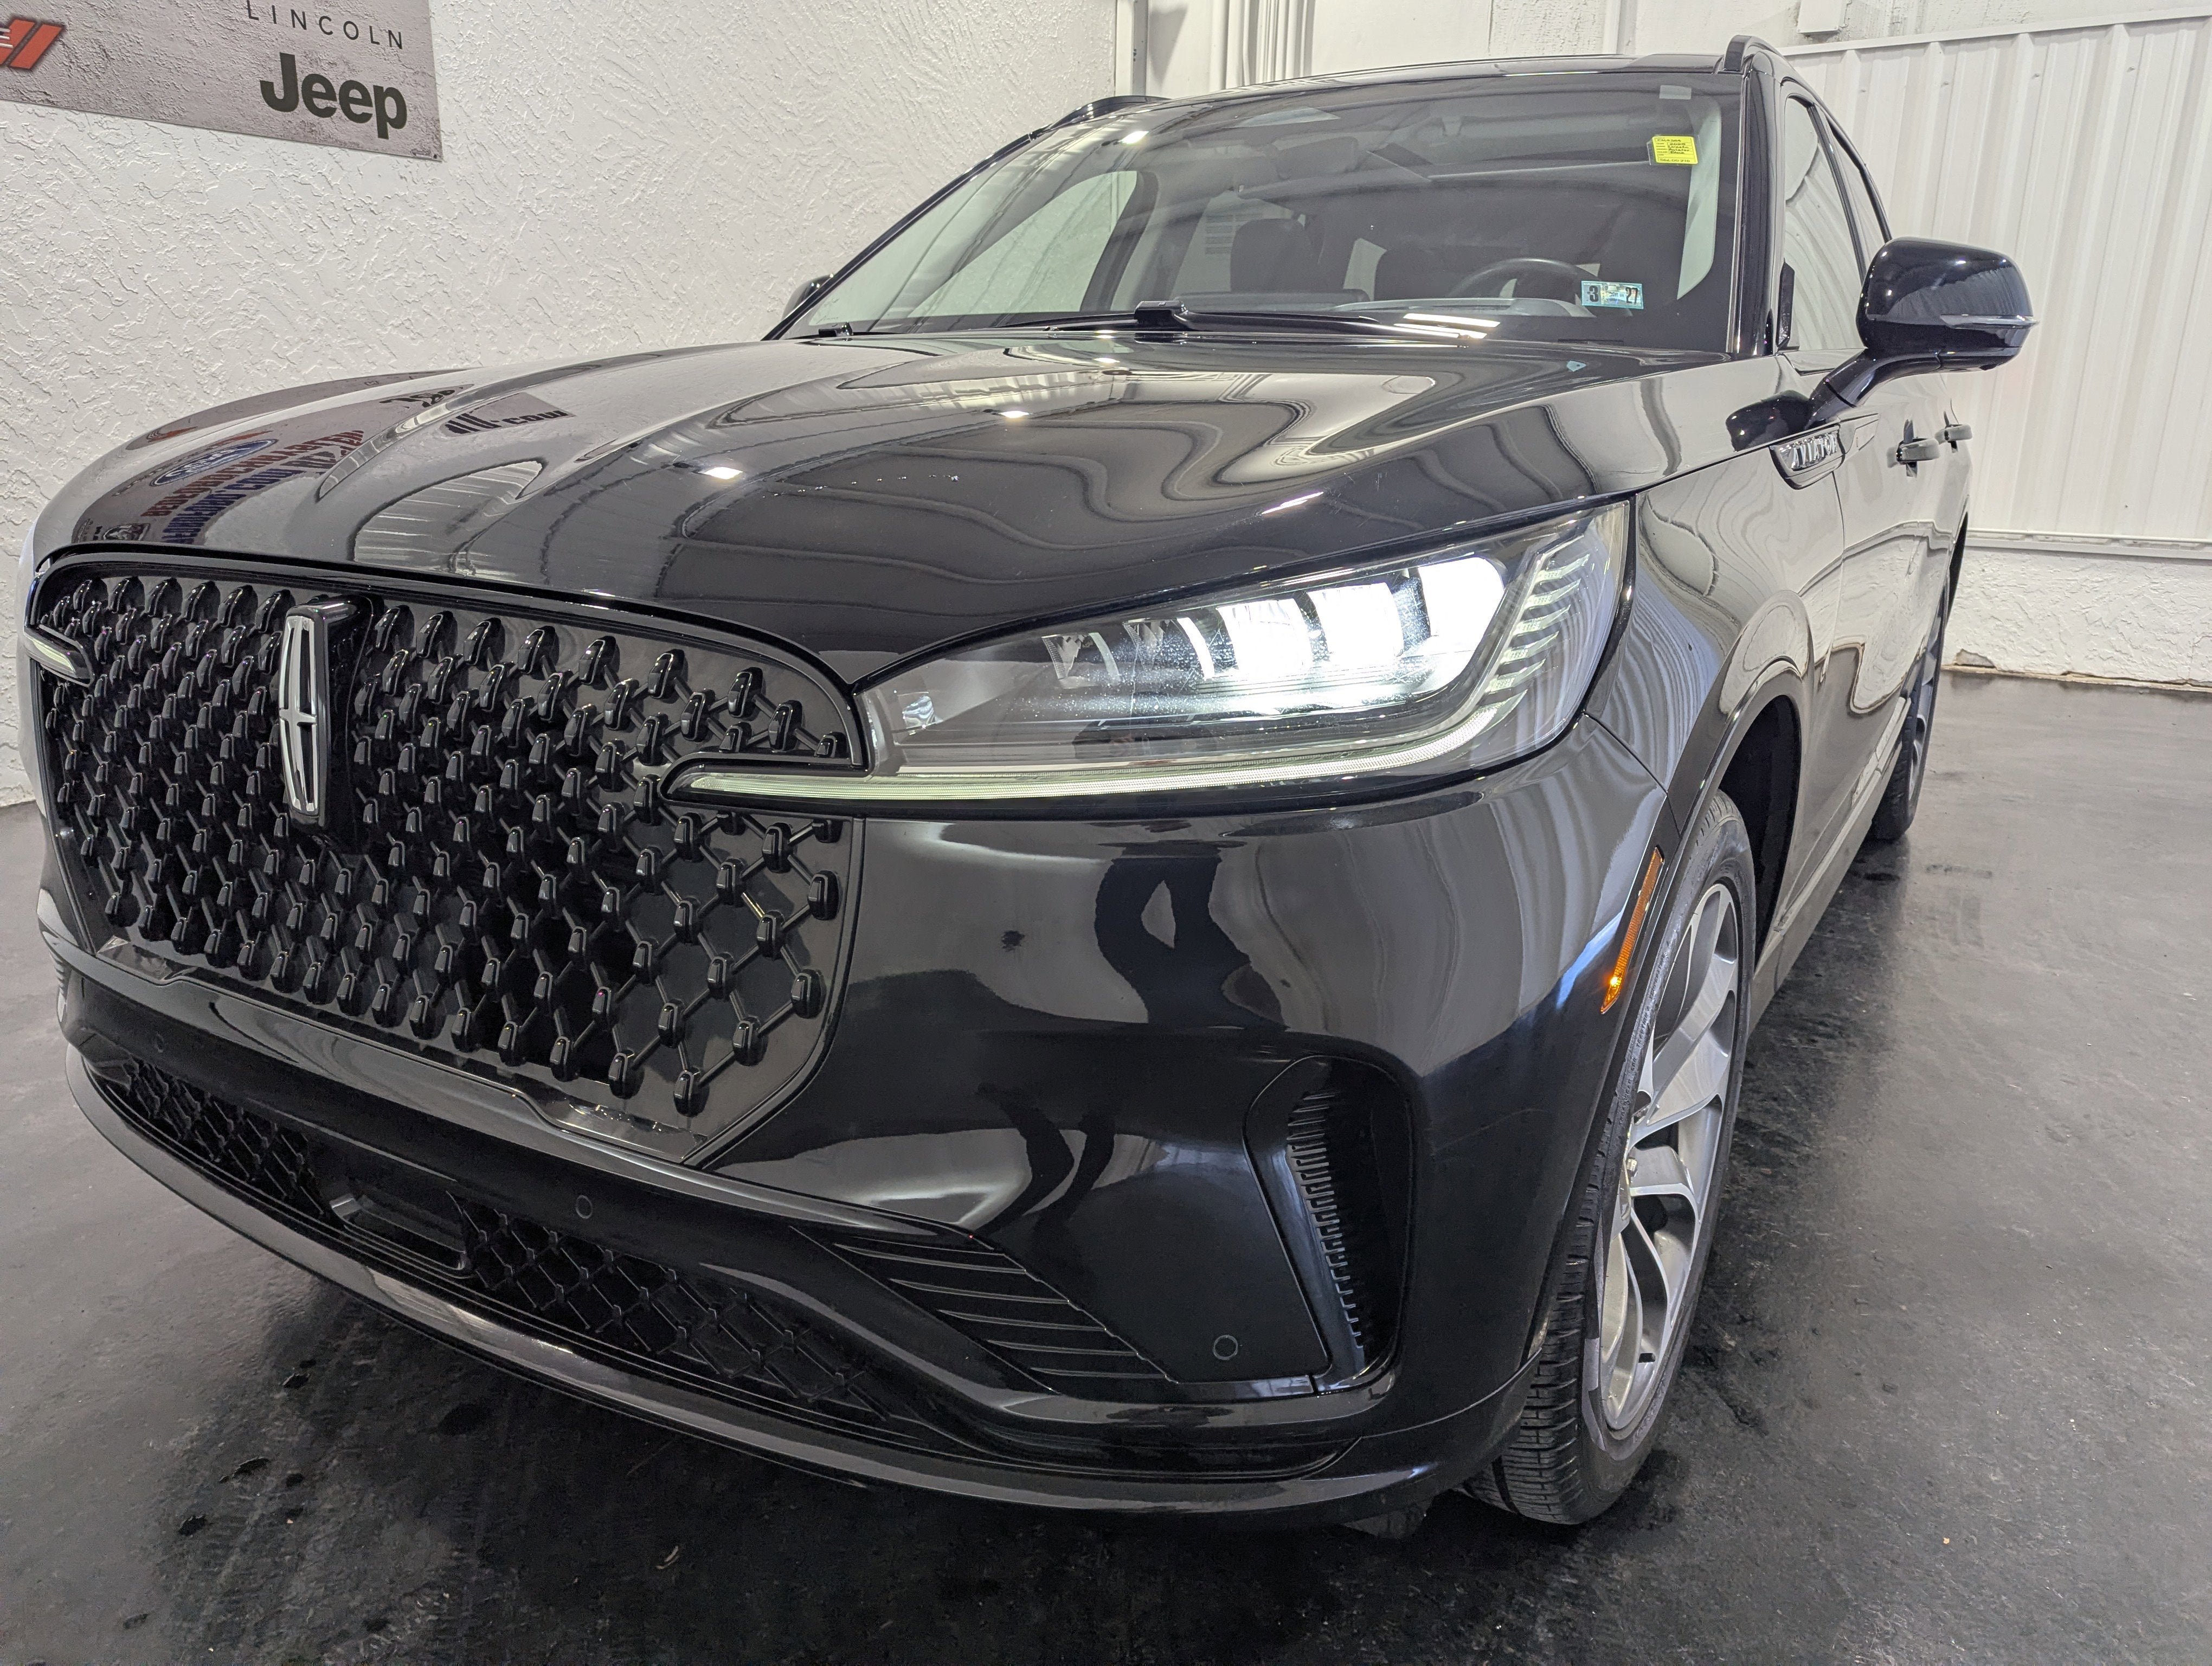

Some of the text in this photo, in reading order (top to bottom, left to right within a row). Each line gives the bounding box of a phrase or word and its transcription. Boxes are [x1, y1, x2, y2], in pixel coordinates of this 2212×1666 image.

[247, 0, 403, 49] LINCOLN
[260, 52, 408, 140] Jeep
[1589, 286, 1599, 302] 3
[1625, 287, 1638, 305] 27
[1791, 432, 1837, 468] AVIATOR
[1636, 1013, 1648, 1048] TRACTION
